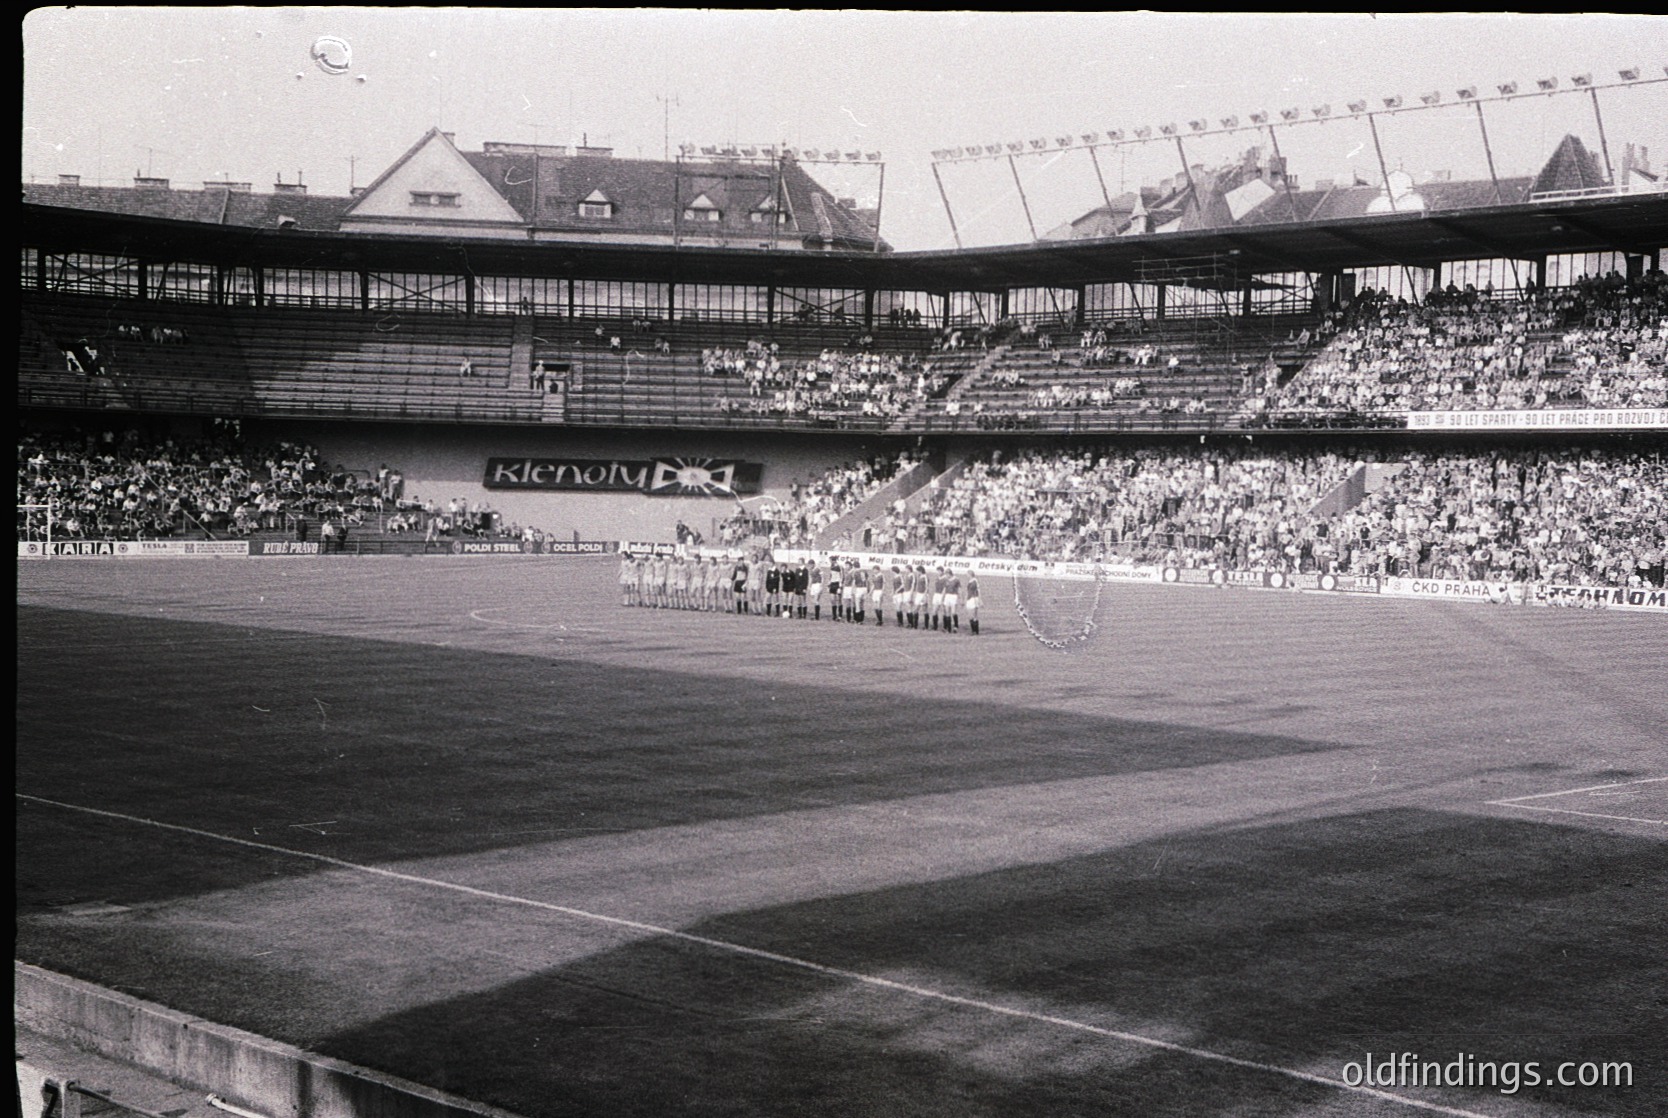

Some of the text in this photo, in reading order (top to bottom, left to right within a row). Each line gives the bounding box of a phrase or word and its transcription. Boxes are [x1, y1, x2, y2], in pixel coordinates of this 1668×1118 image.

[1450, 414, 1462, 426] 90
[1465, 414, 1479, 426] LET
[1482, 413, 1517, 425] SPARTY
[1525, 413, 1538, 425] 90
[1541, 413, 1556, 425] LET
[1593, 412, 1613, 425] PRO
[1617, 412, 1655, 424] ROZVOJ
[493, 459, 648, 488] Klenoty
[43, 542, 113, 555] KARA
[262, 540, 289, 554] RUDÉ
[289, 541, 319, 554] PRÁVO
[464, 543, 521, 552] POLDI STEEL
[553, 543, 603, 552] OCEL POLDI
[1412, 581, 1491, 597] ČKD PRAHA
